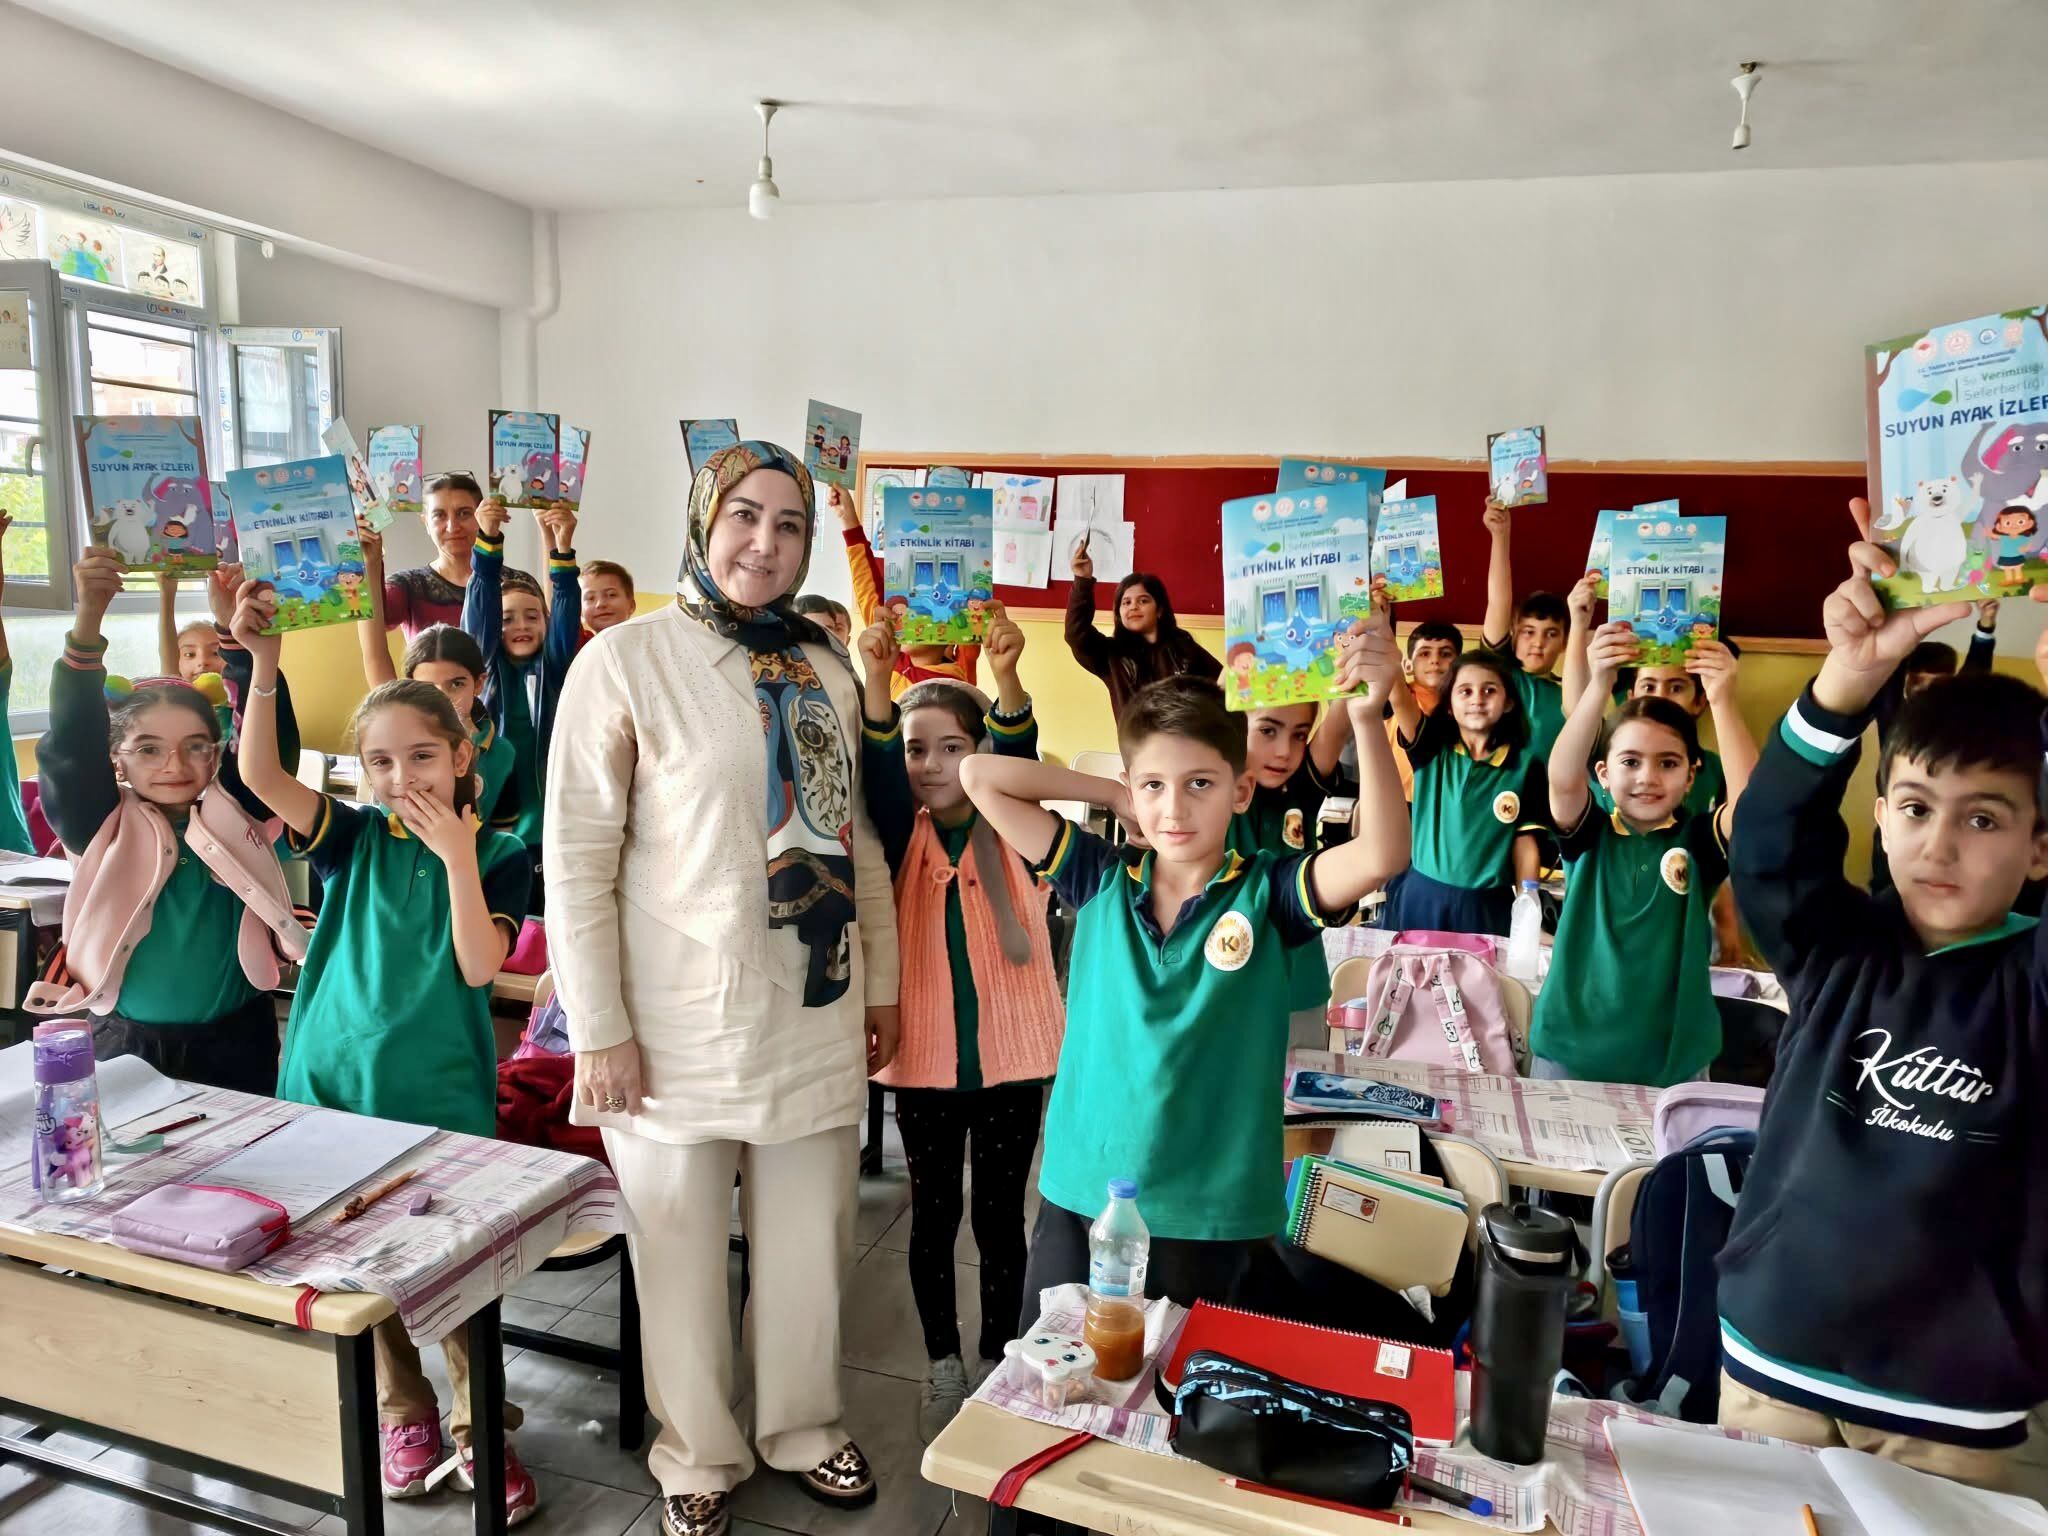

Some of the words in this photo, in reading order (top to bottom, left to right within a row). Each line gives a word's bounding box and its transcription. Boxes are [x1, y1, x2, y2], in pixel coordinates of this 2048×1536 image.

[1885, 414, 1944, 438] SUYUN
[1949, 404, 1993, 426] AYAK
[91, 463, 129, 472] SUYUN
[132, 462, 158, 472] AYAK
[160, 462, 194, 472] İZLERİ
[899, 536, 941, 547] ETKİNLİK
[945, 536, 975, 548] KİTABI
[1242, 556, 1296, 577] ETKİNLİK
[1301, 551, 1341, 568] KİTABI
[1626, 564, 1671, 575] ETKİNLİK
[1673, 564, 1704, 575] KİTABI
[1221, 935, 1238, 952] K
[1865, 1103, 1955, 1142] İlkokulu
